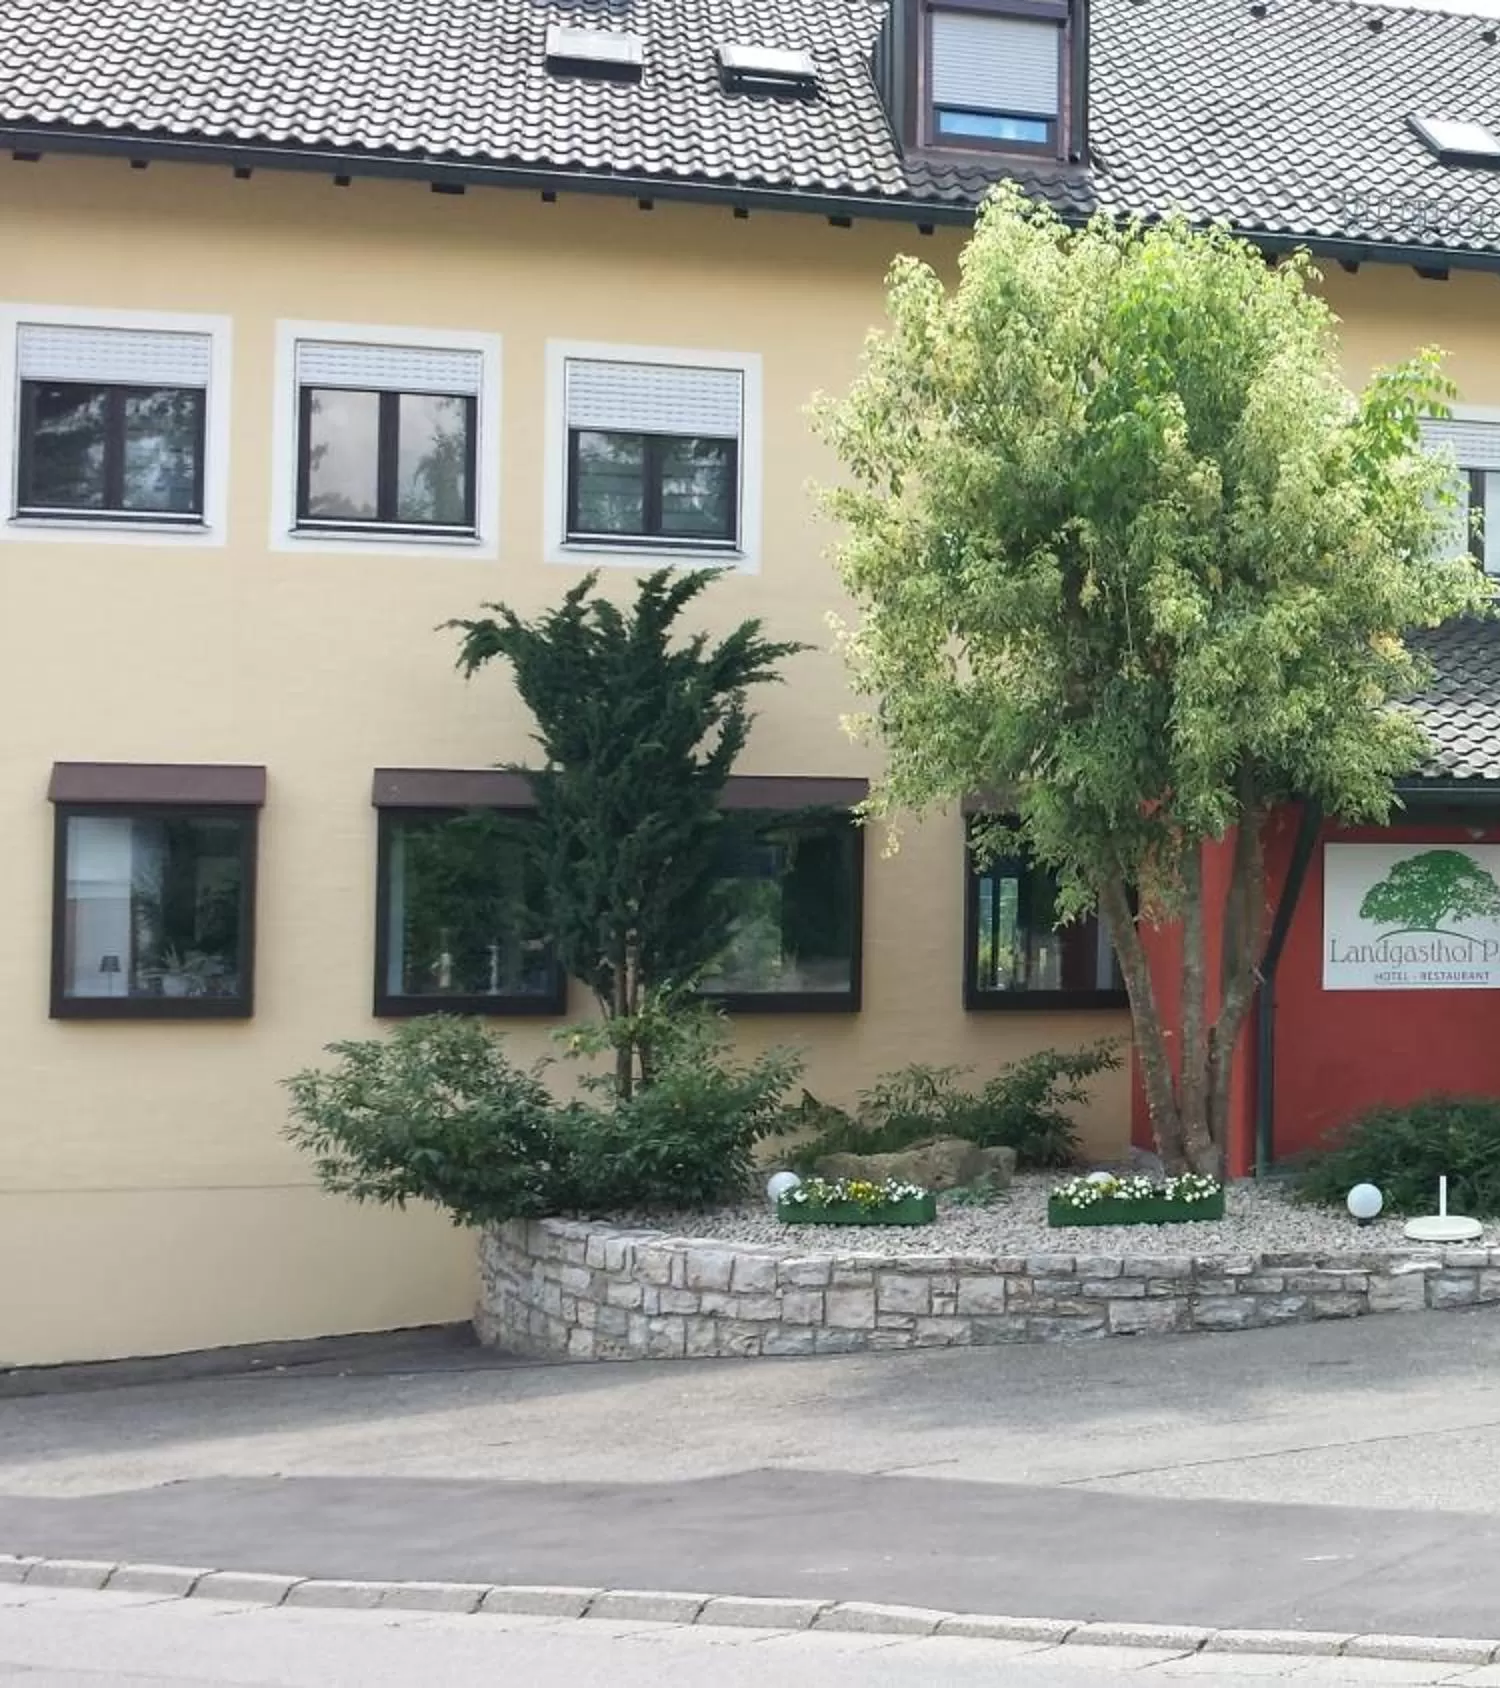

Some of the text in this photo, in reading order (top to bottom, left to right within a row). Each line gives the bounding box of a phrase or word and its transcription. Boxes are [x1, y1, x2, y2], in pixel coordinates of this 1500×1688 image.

[1330, 939, 1473, 968] Landgasthof
[1374, 971, 1489, 981] HOTEL RESTAURANT
